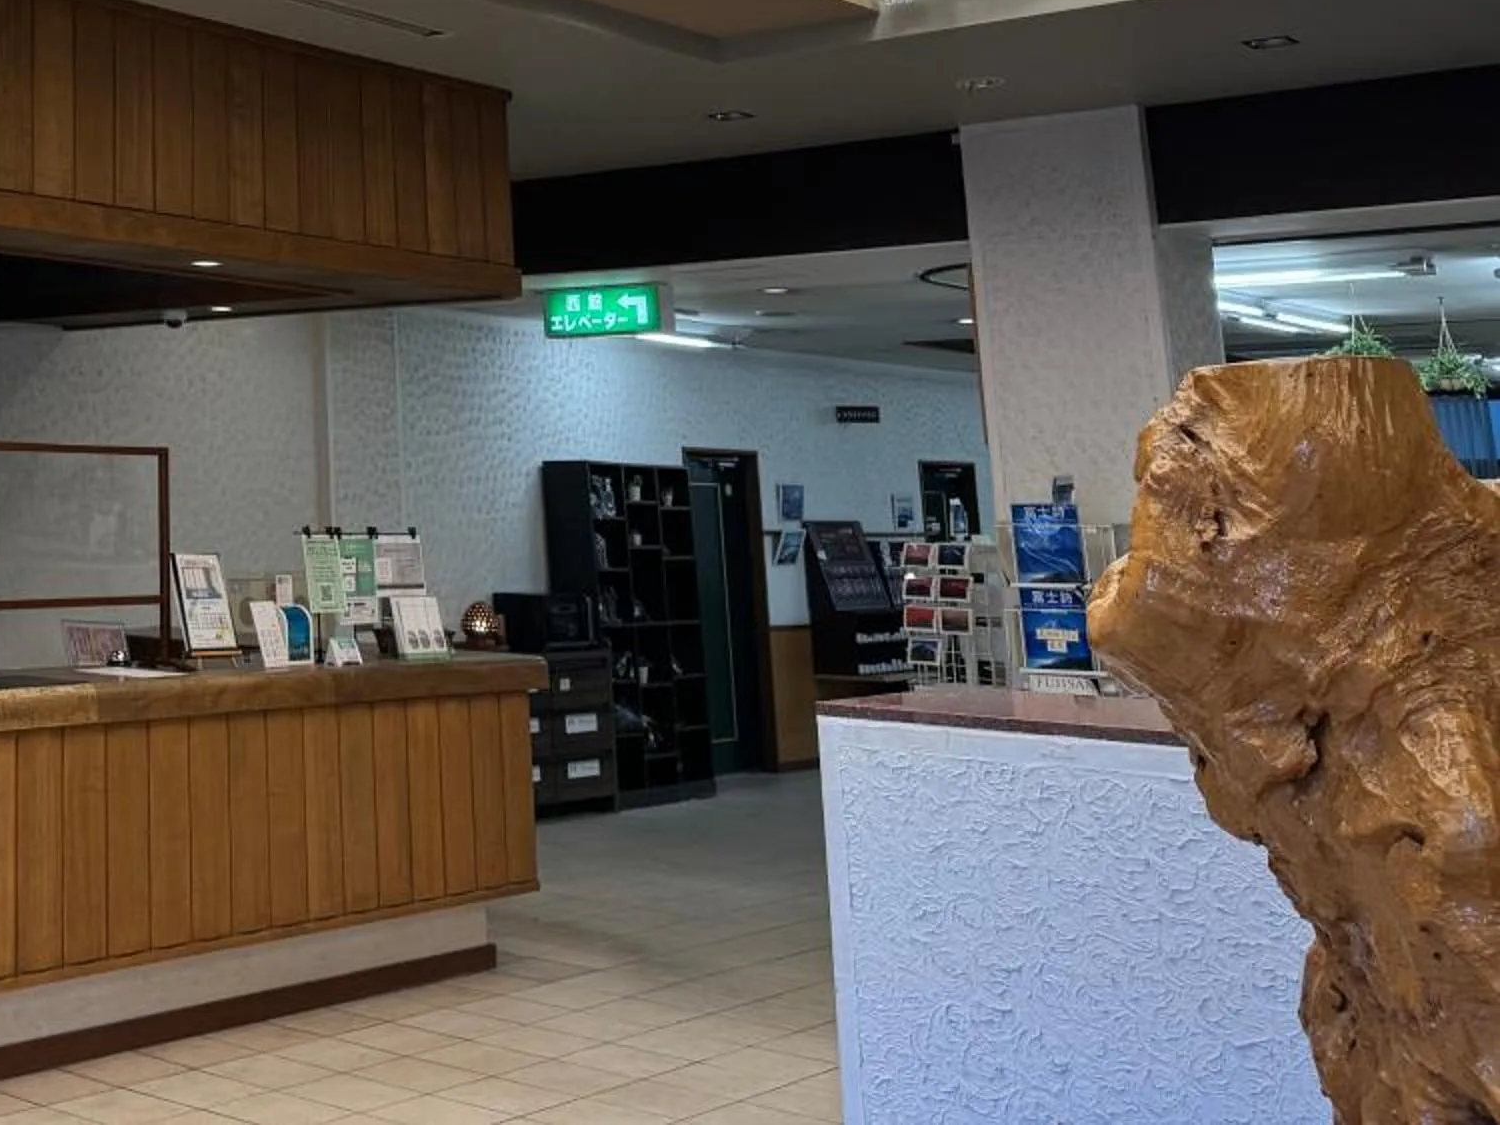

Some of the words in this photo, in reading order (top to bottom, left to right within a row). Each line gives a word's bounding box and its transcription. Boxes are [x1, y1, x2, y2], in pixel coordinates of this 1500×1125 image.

[550, 312, 629, 331] エレベーター
